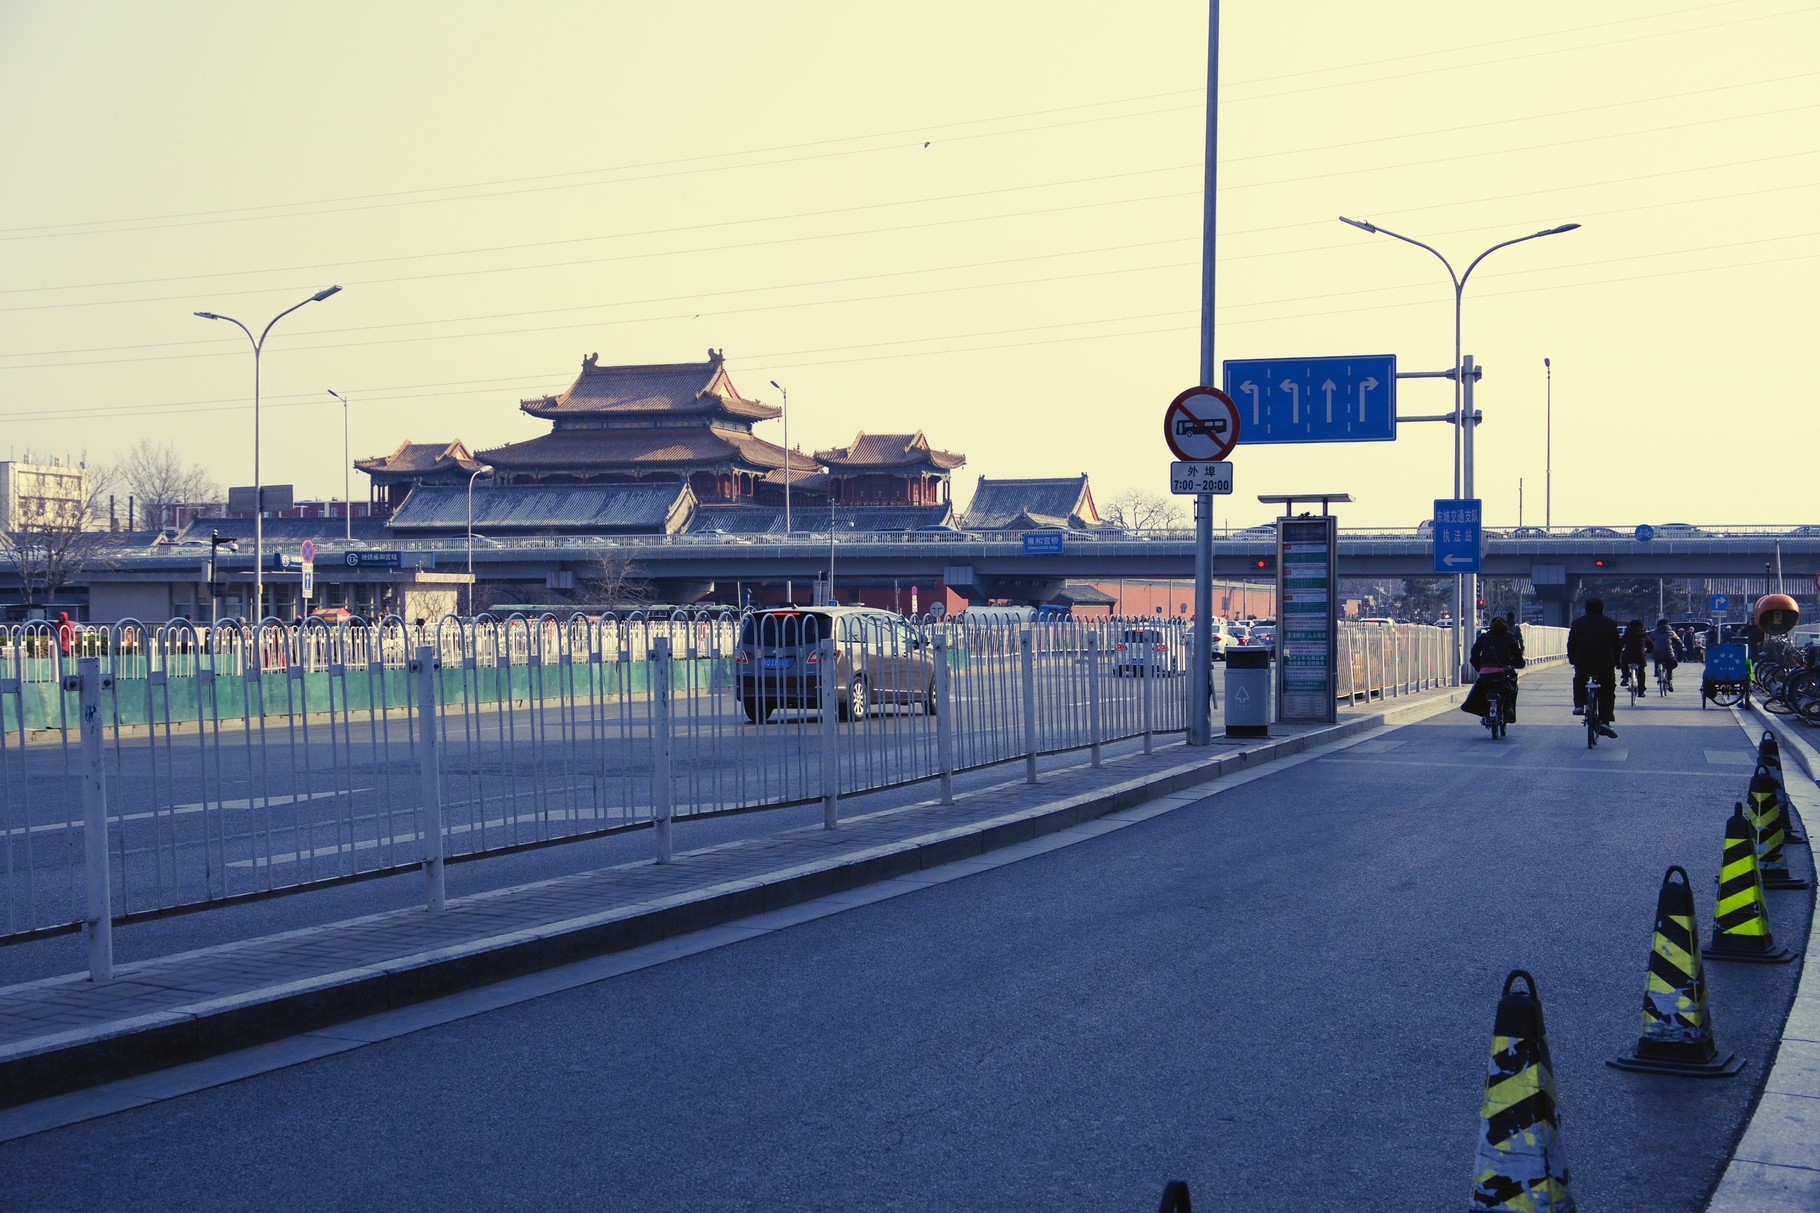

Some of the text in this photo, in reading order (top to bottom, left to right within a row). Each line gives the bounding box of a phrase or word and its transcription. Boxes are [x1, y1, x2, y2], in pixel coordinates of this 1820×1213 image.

[1188, 466, 1216, 477] 外埠
[1436, 509, 1478, 523] 东城交通支队
[1027, 536, 1059, 545] 雍和宫桥
[1442, 529, 1472, 543] 执法站
